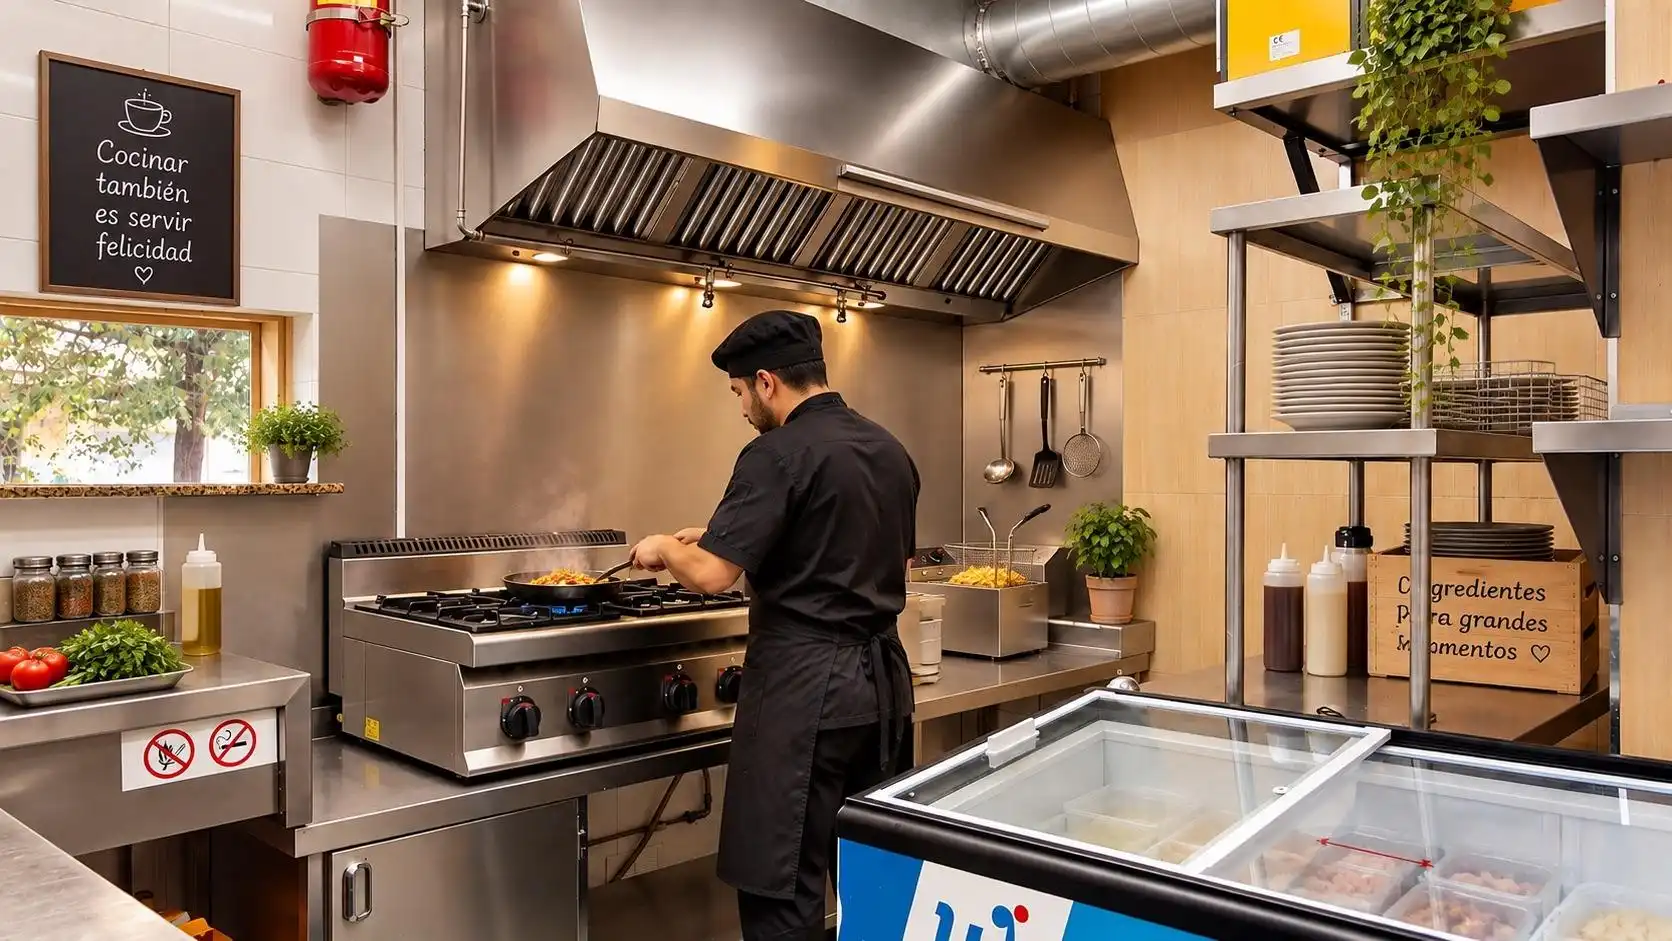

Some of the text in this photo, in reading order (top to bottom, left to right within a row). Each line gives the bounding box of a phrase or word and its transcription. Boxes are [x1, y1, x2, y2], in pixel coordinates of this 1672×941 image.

[97, 139, 188, 173] Cocinar
[96, 172, 189, 203] también
[95, 208, 193, 232] es servir
[96, 231, 193, 263] felicidad
[1396, 604, 1548, 634] Pra grandes
